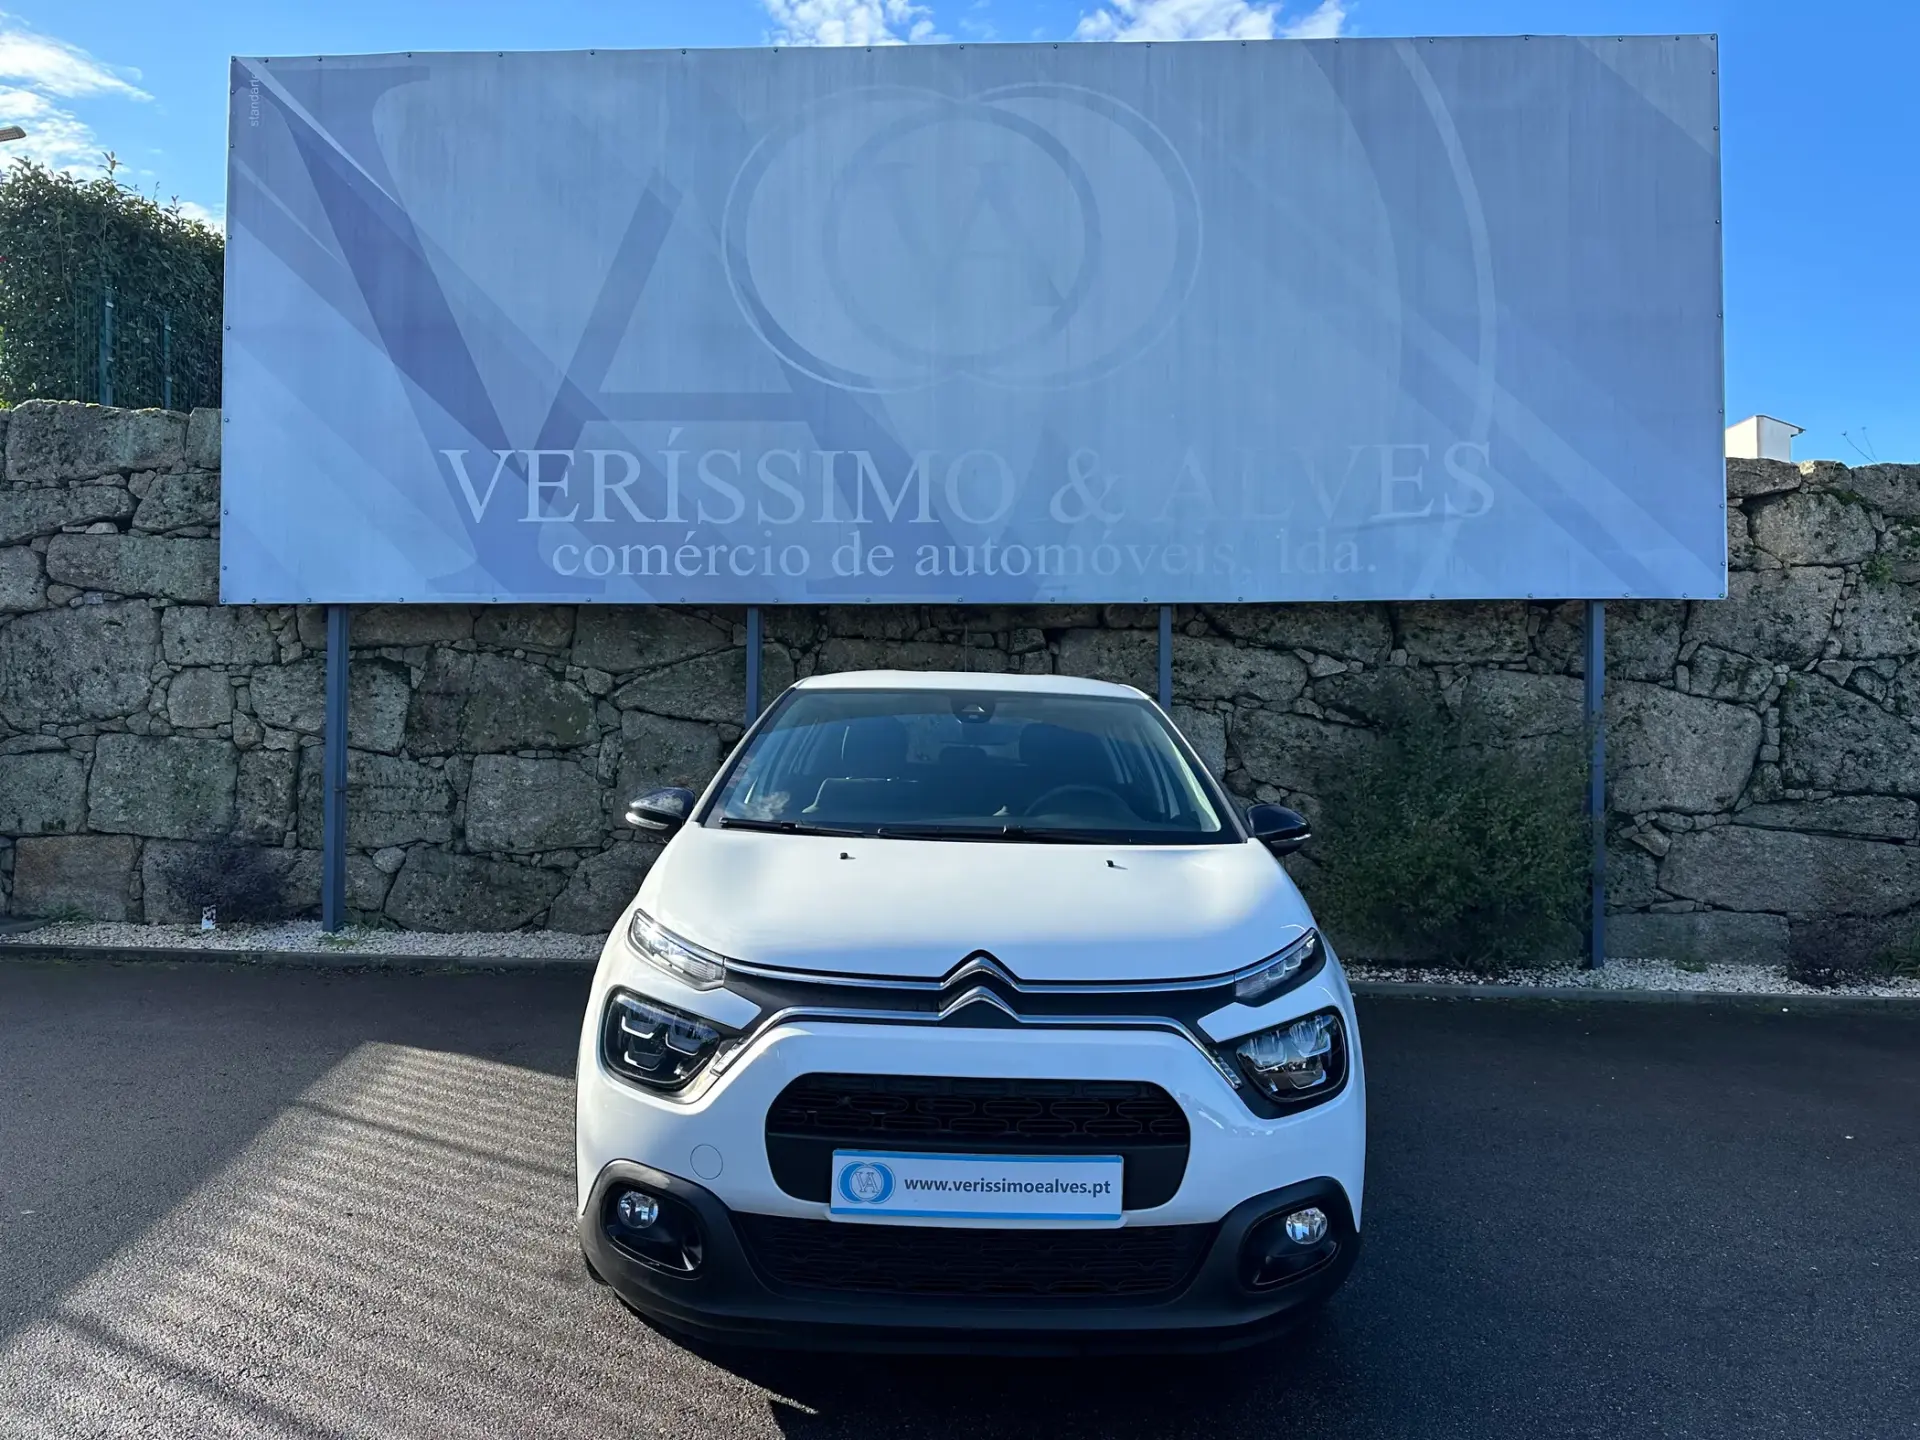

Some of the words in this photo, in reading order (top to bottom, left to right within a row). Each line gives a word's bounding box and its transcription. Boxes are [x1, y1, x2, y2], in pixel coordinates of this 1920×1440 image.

[438, 426, 1016, 525] VERÍSSIMO
[1049, 447, 1127, 525] &
[1150, 440, 1496, 523] ALVES
[551, 529, 811, 578] comércio
[830, 530, 896, 578] de
[903, 1176, 1112, 1199] www.verissimoealves.pt
